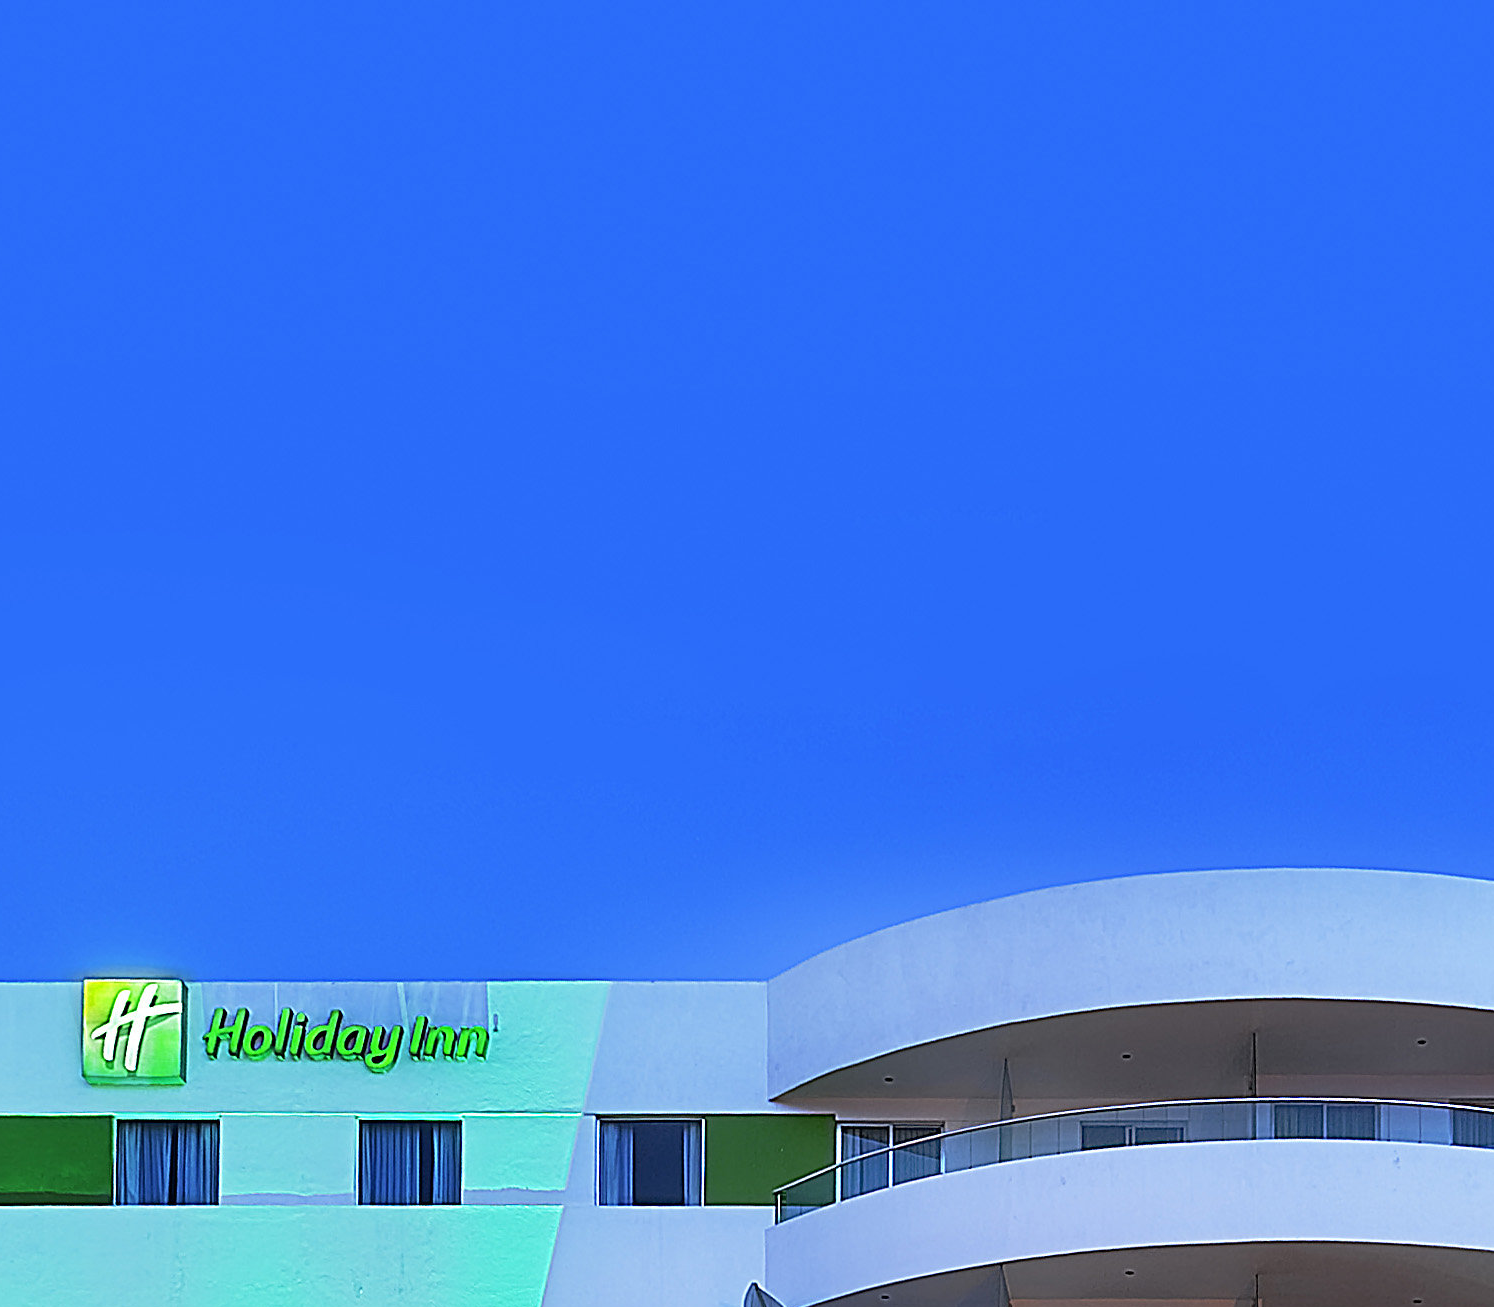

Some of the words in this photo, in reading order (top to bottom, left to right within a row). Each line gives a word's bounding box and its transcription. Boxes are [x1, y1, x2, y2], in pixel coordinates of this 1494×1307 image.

[91, 982, 182, 1072] H
[203, 1007, 404, 1073] Holiday
[409, 1015, 489, 1061] Inn
